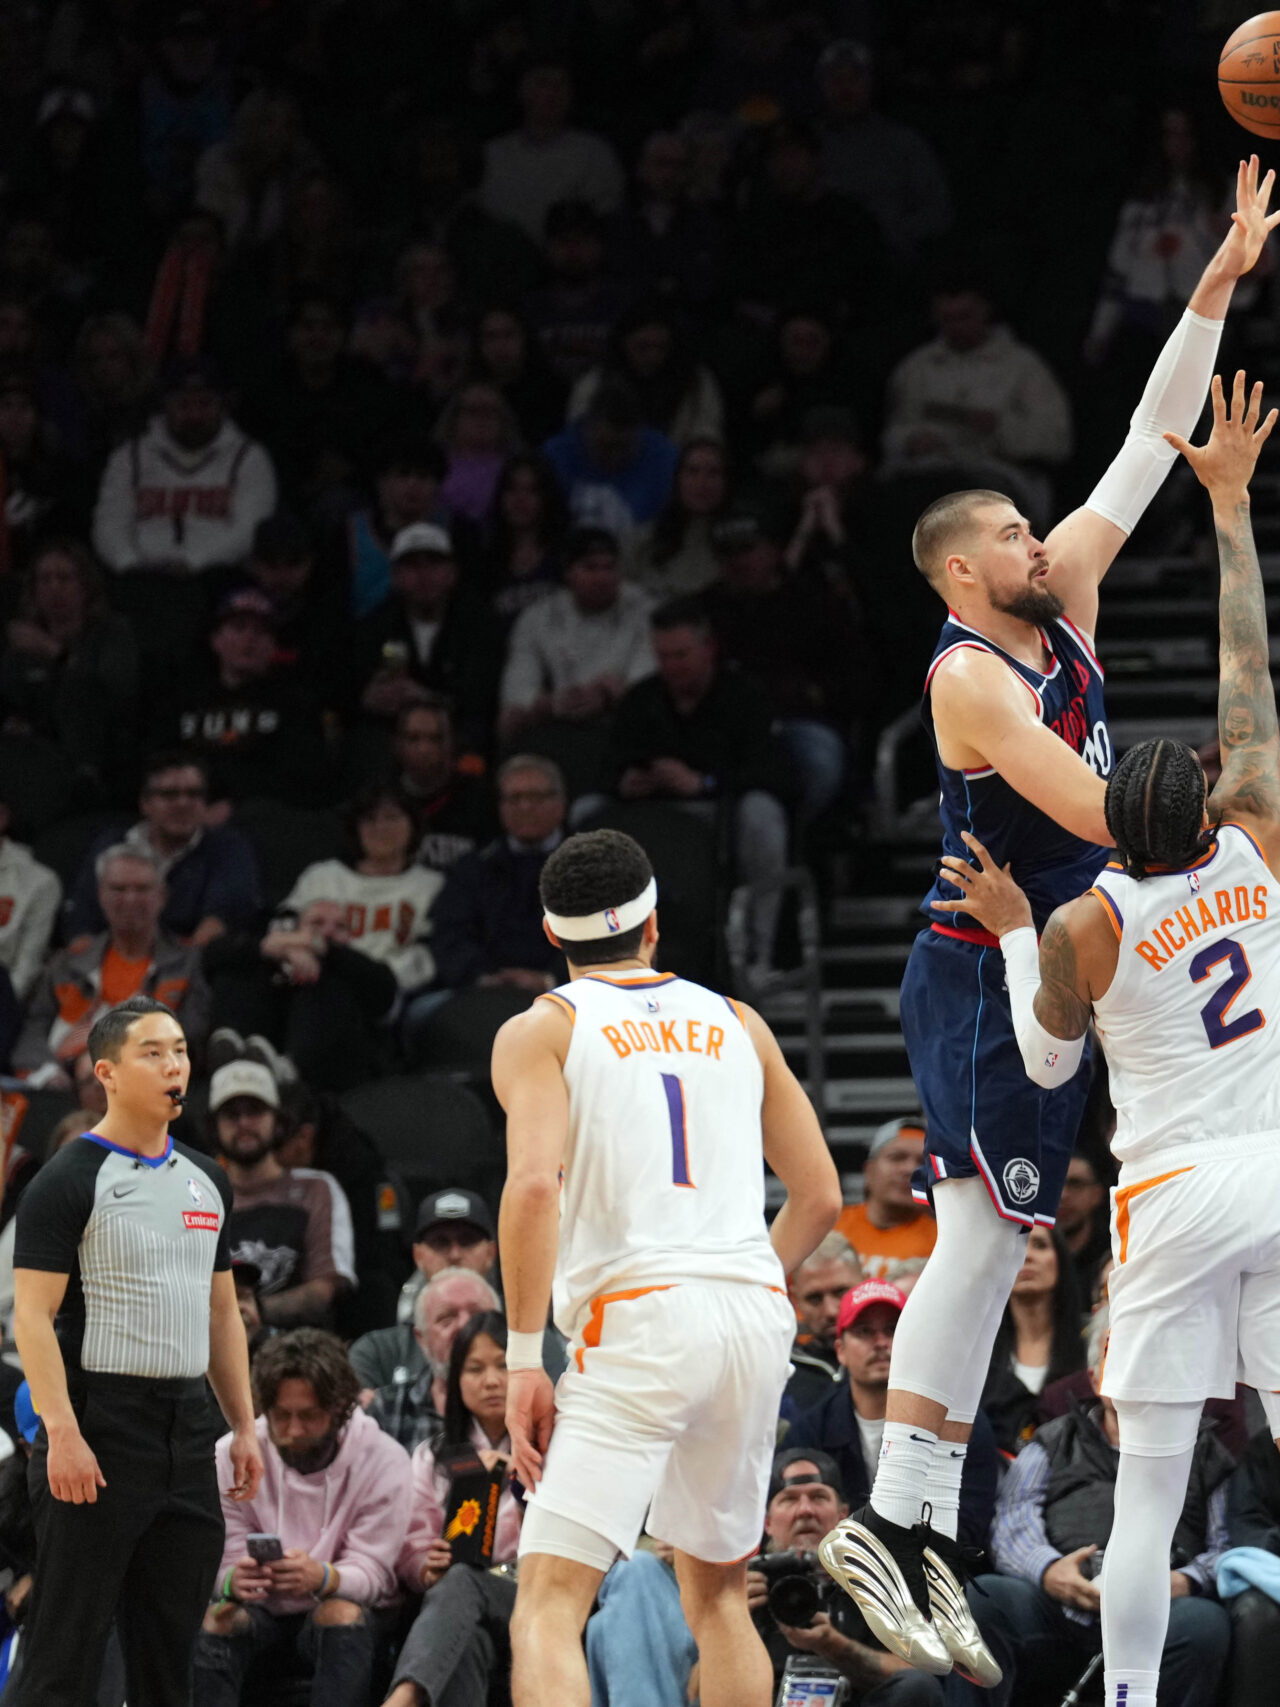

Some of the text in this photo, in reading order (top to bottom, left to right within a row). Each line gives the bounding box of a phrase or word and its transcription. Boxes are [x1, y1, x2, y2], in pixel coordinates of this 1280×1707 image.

[1134, 885, 1268, 972] RICHARDS
[601, 1019, 725, 1061] BOOKER
[1188, 937, 1266, 1050] 2
[659, 1072, 697, 1189] 1
